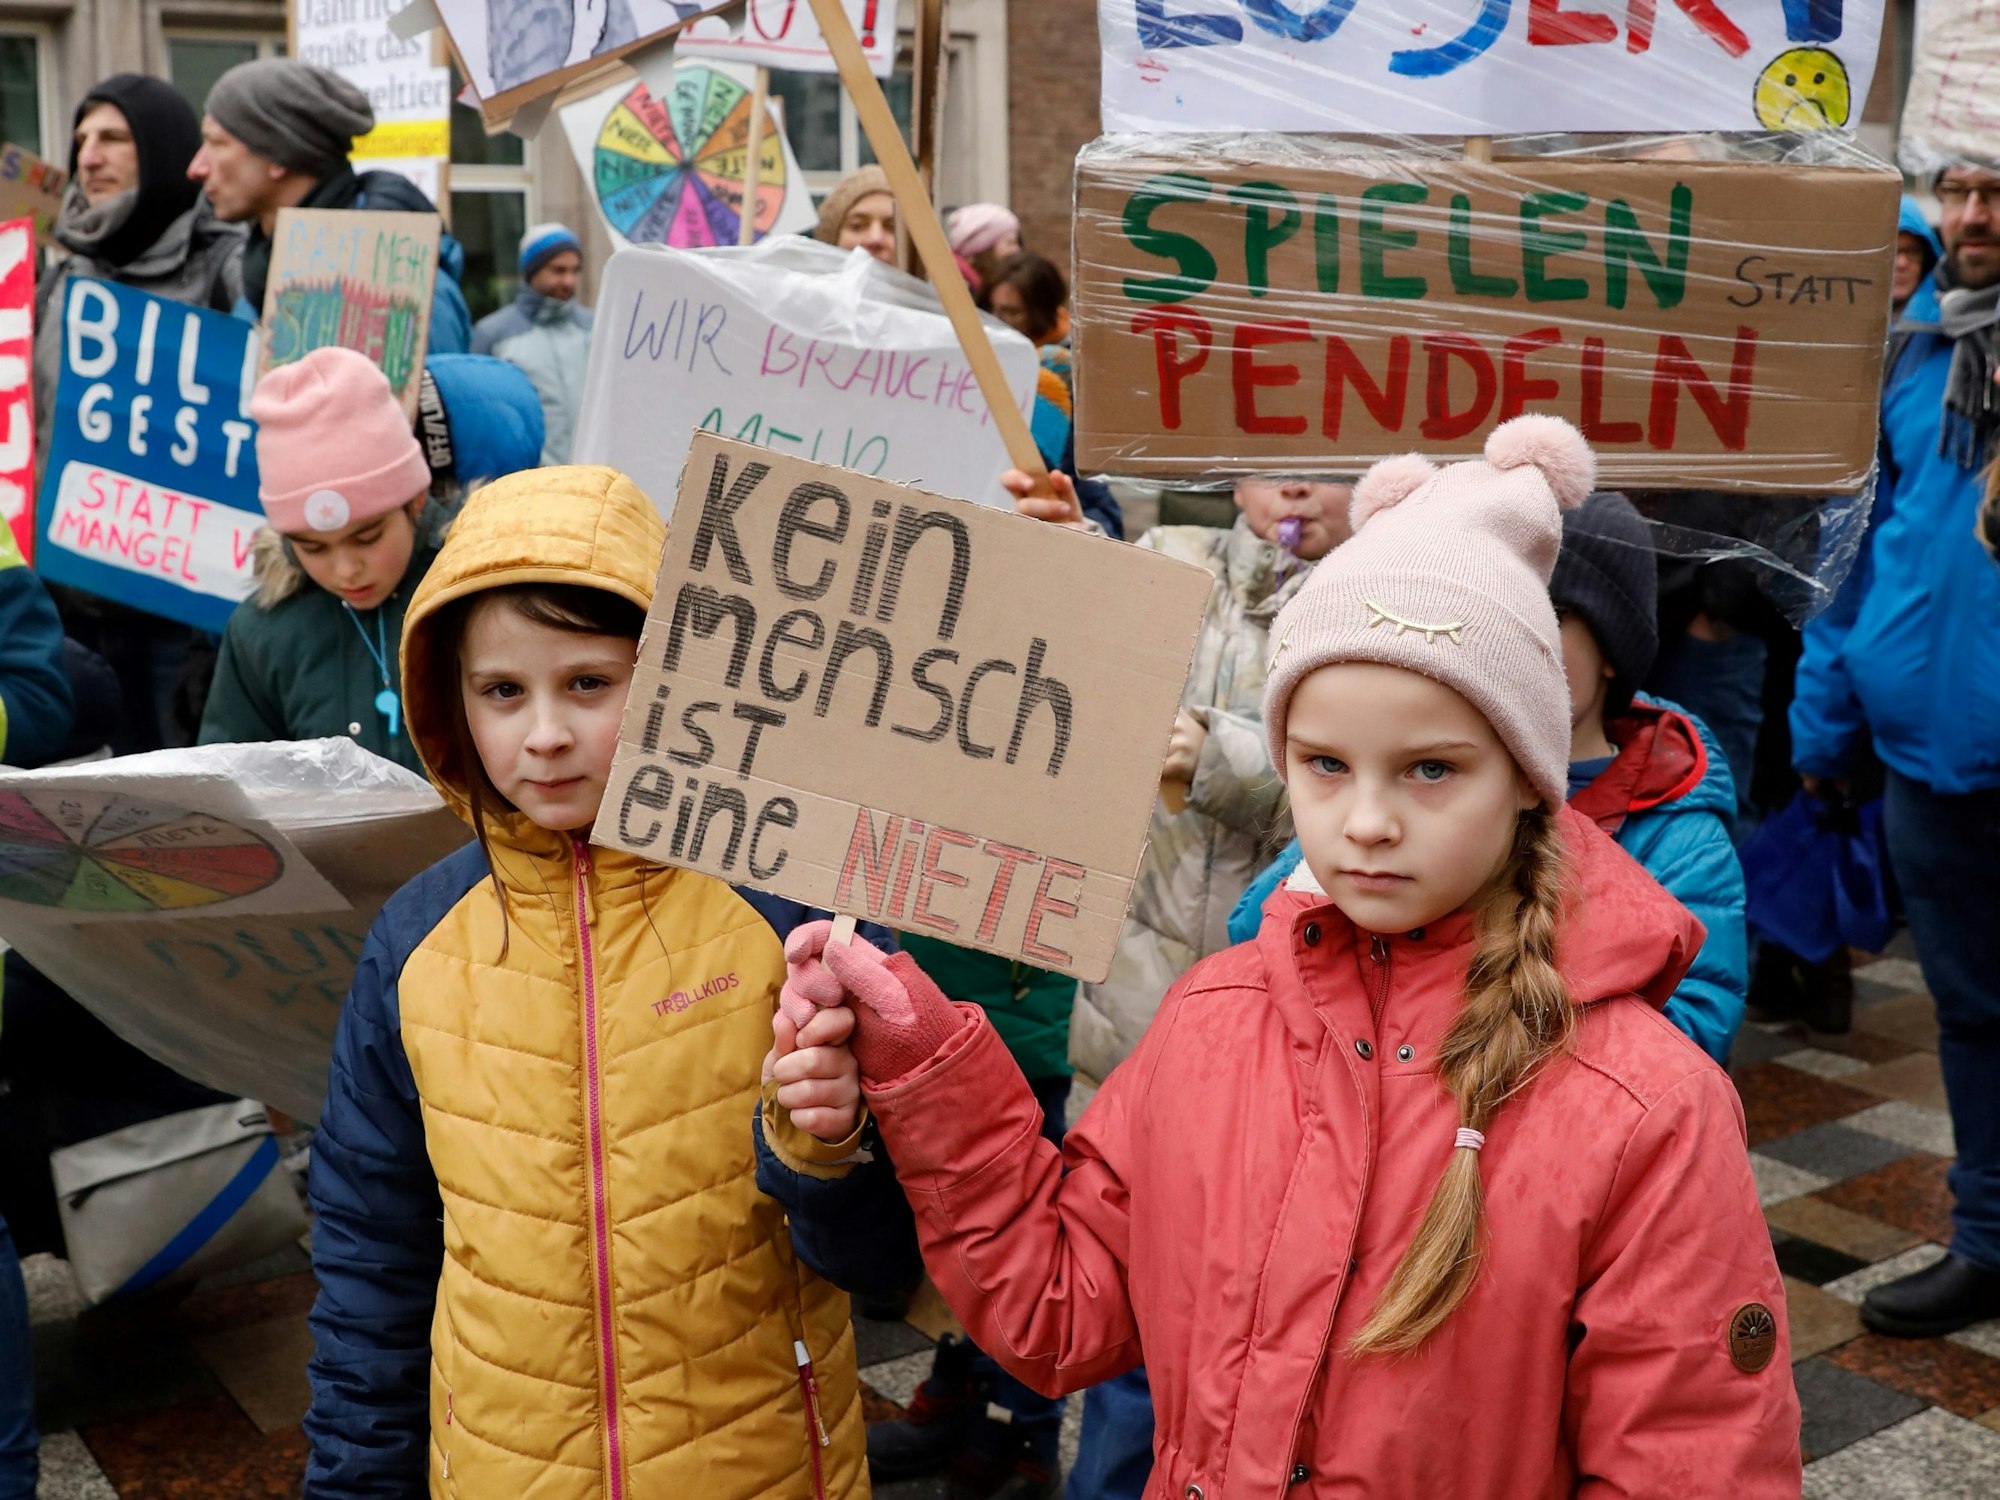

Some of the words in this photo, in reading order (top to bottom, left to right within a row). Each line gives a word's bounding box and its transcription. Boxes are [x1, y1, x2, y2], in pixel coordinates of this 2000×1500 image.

[281, 219, 367, 277] BAUT
[1121, 173, 1694, 310] SPIELEN
[1727, 256, 1873, 307] STATT
[623, 290, 732, 376] WIR
[1130, 304, 1758, 451] PENDELN
[56, 508, 199, 583] MANGEL
[80, 470, 211, 534] STATT
[688, 452, 972, 641] Kein
[662, 582, 1073, 778] mensch
[618, 763, 799, 881] eine
